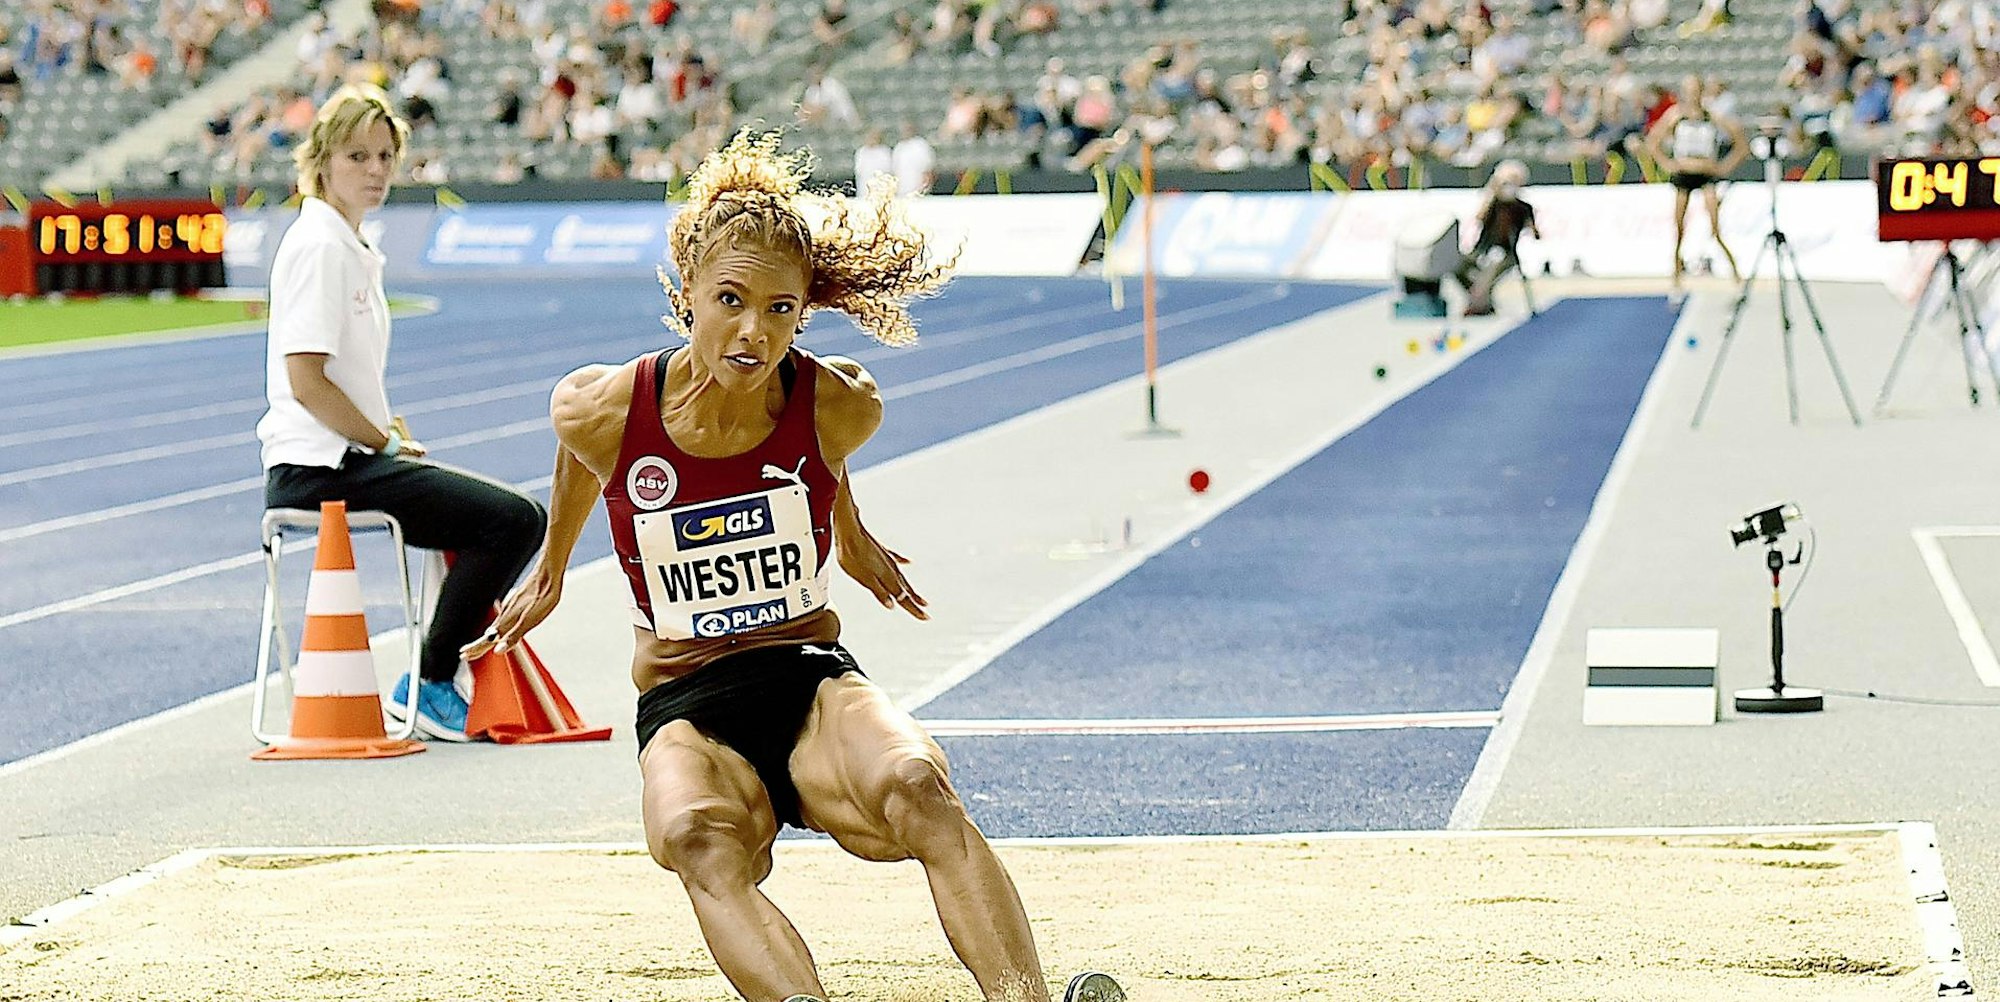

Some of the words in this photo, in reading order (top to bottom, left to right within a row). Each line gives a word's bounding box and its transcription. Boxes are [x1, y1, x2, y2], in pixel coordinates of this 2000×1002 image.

[725, 508, 764, 534] GLS
[658, 543, 802, 603] WESTER
[800, 587, 813, 608] 466
[732, 604, 785, 628] PLAN
